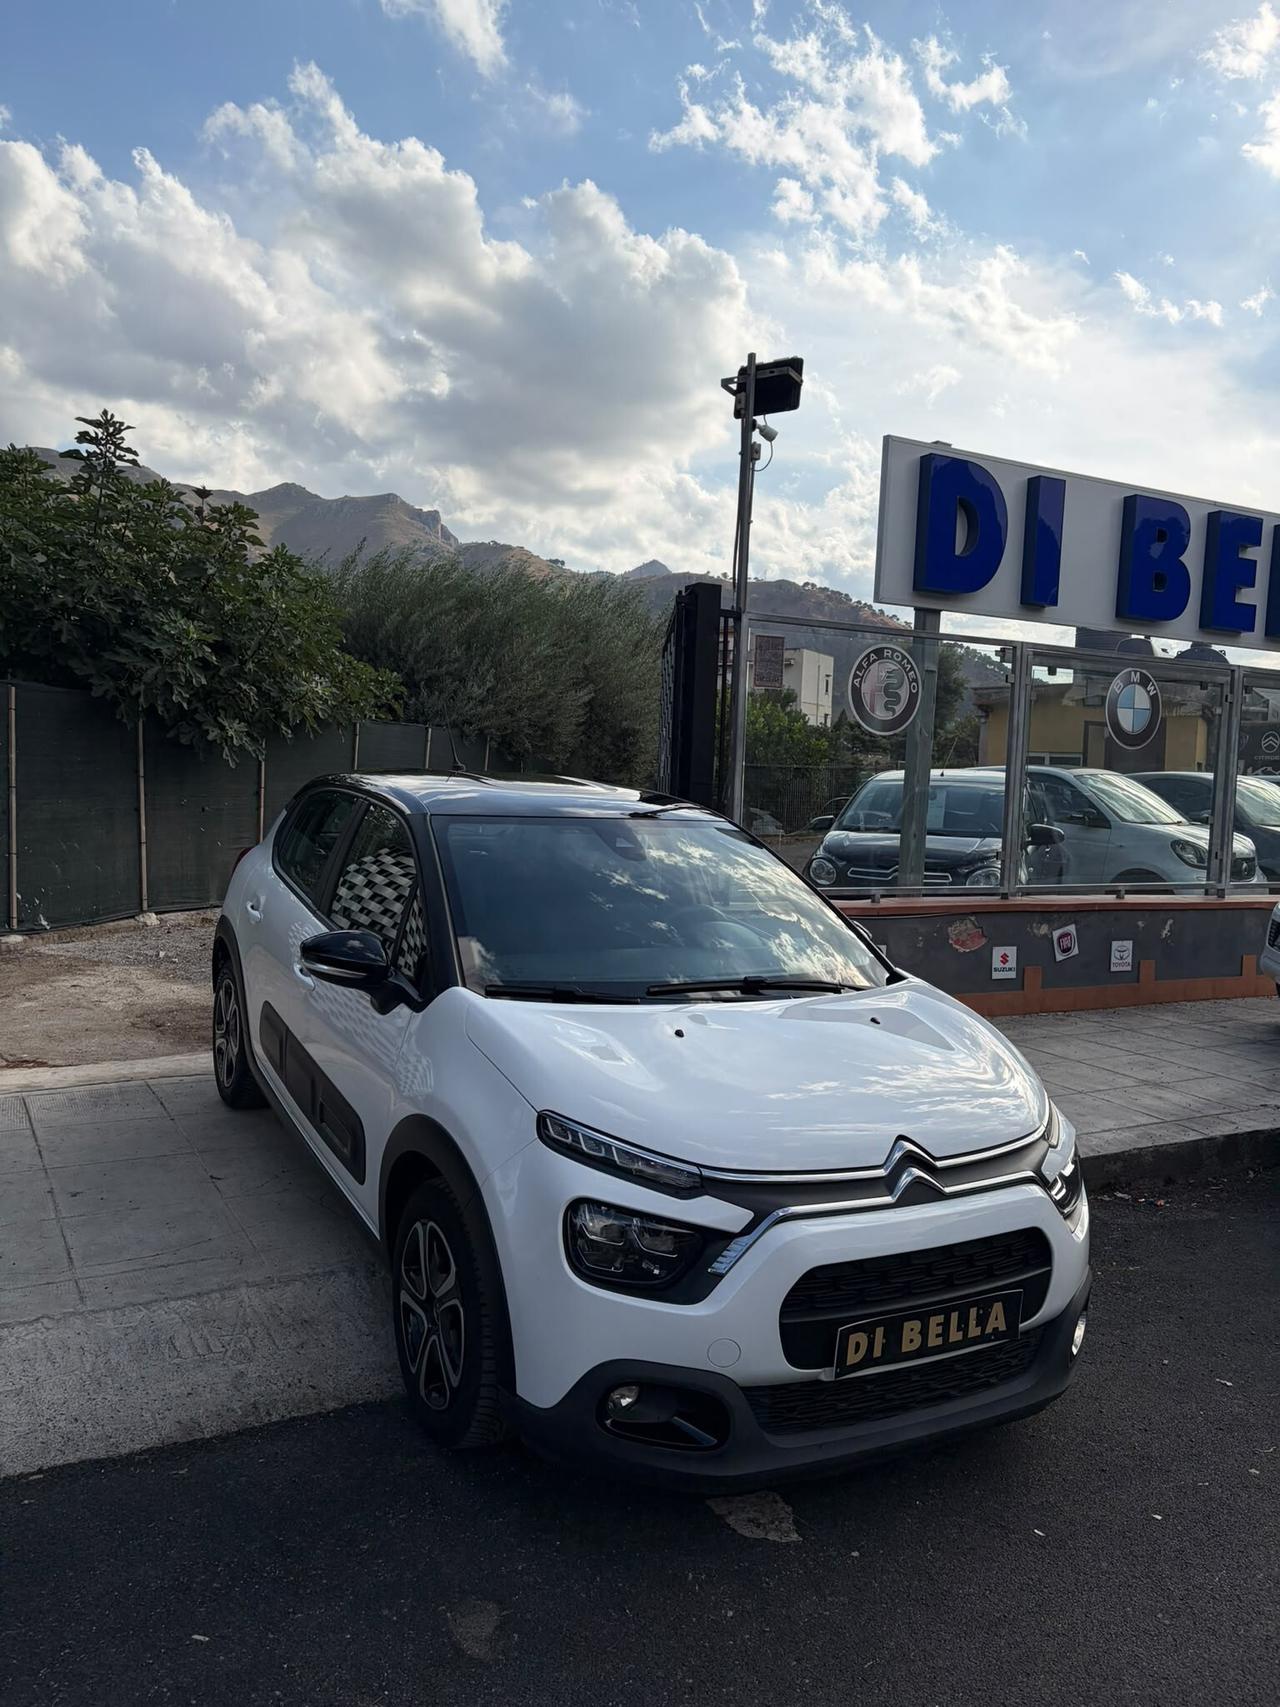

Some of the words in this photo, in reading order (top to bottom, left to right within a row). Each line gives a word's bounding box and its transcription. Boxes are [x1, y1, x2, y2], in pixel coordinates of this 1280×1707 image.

[913, 452, 1067, 608] DI
[853, 652, 878, 688] ALFA
[883, 649, 918, 693] ROMEO
[1113, 671, 1157, 696] BMW
[846, 1326, 884, 1366] DI
[901, 1301, 1007, 1352] BELLA
